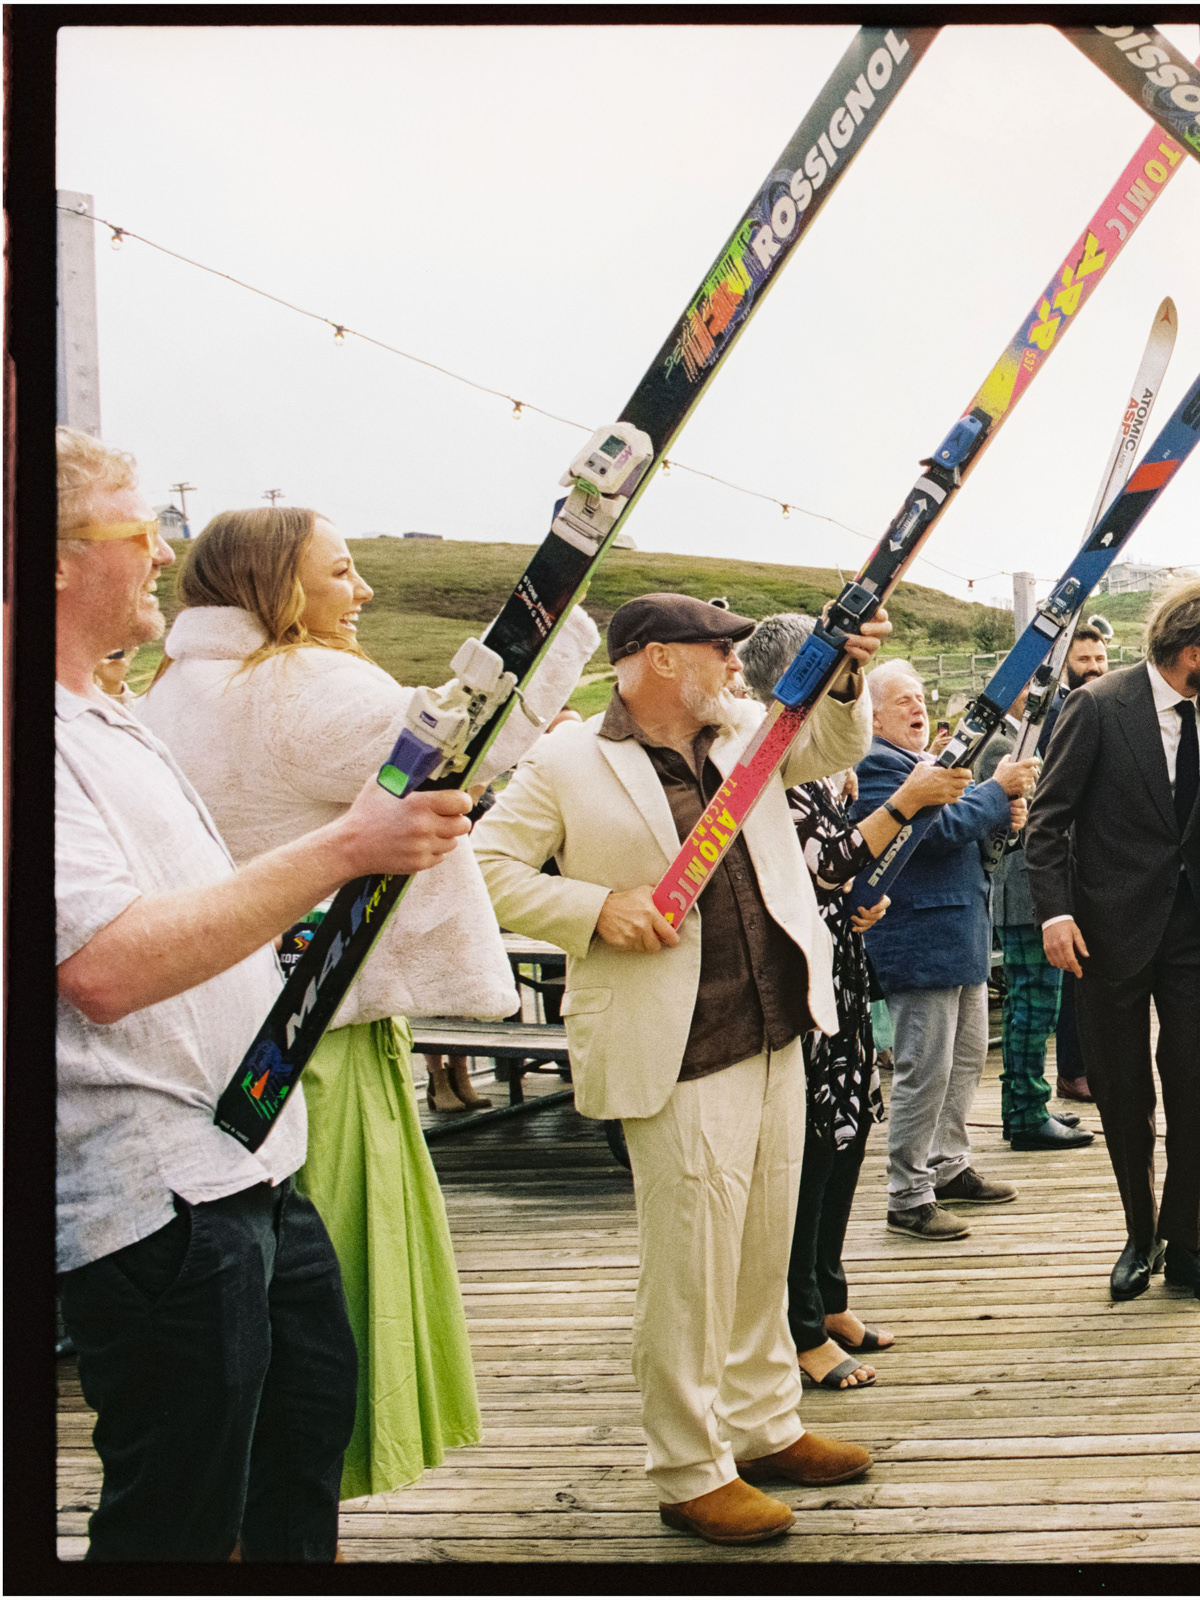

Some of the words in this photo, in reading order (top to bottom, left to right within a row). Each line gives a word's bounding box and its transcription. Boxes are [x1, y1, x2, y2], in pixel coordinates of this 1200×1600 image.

[751, 29, 910, 271] ROSSIGNOL
[1105, 132, 1182, 242] TOMIC
[1121, 397, 1139, 436] ASP
[1125, 387, 1153, 452] ATOMIC
[690, 778, 738, 847] TRICOMP
[669, 807, 738, 912] ATOMIC
